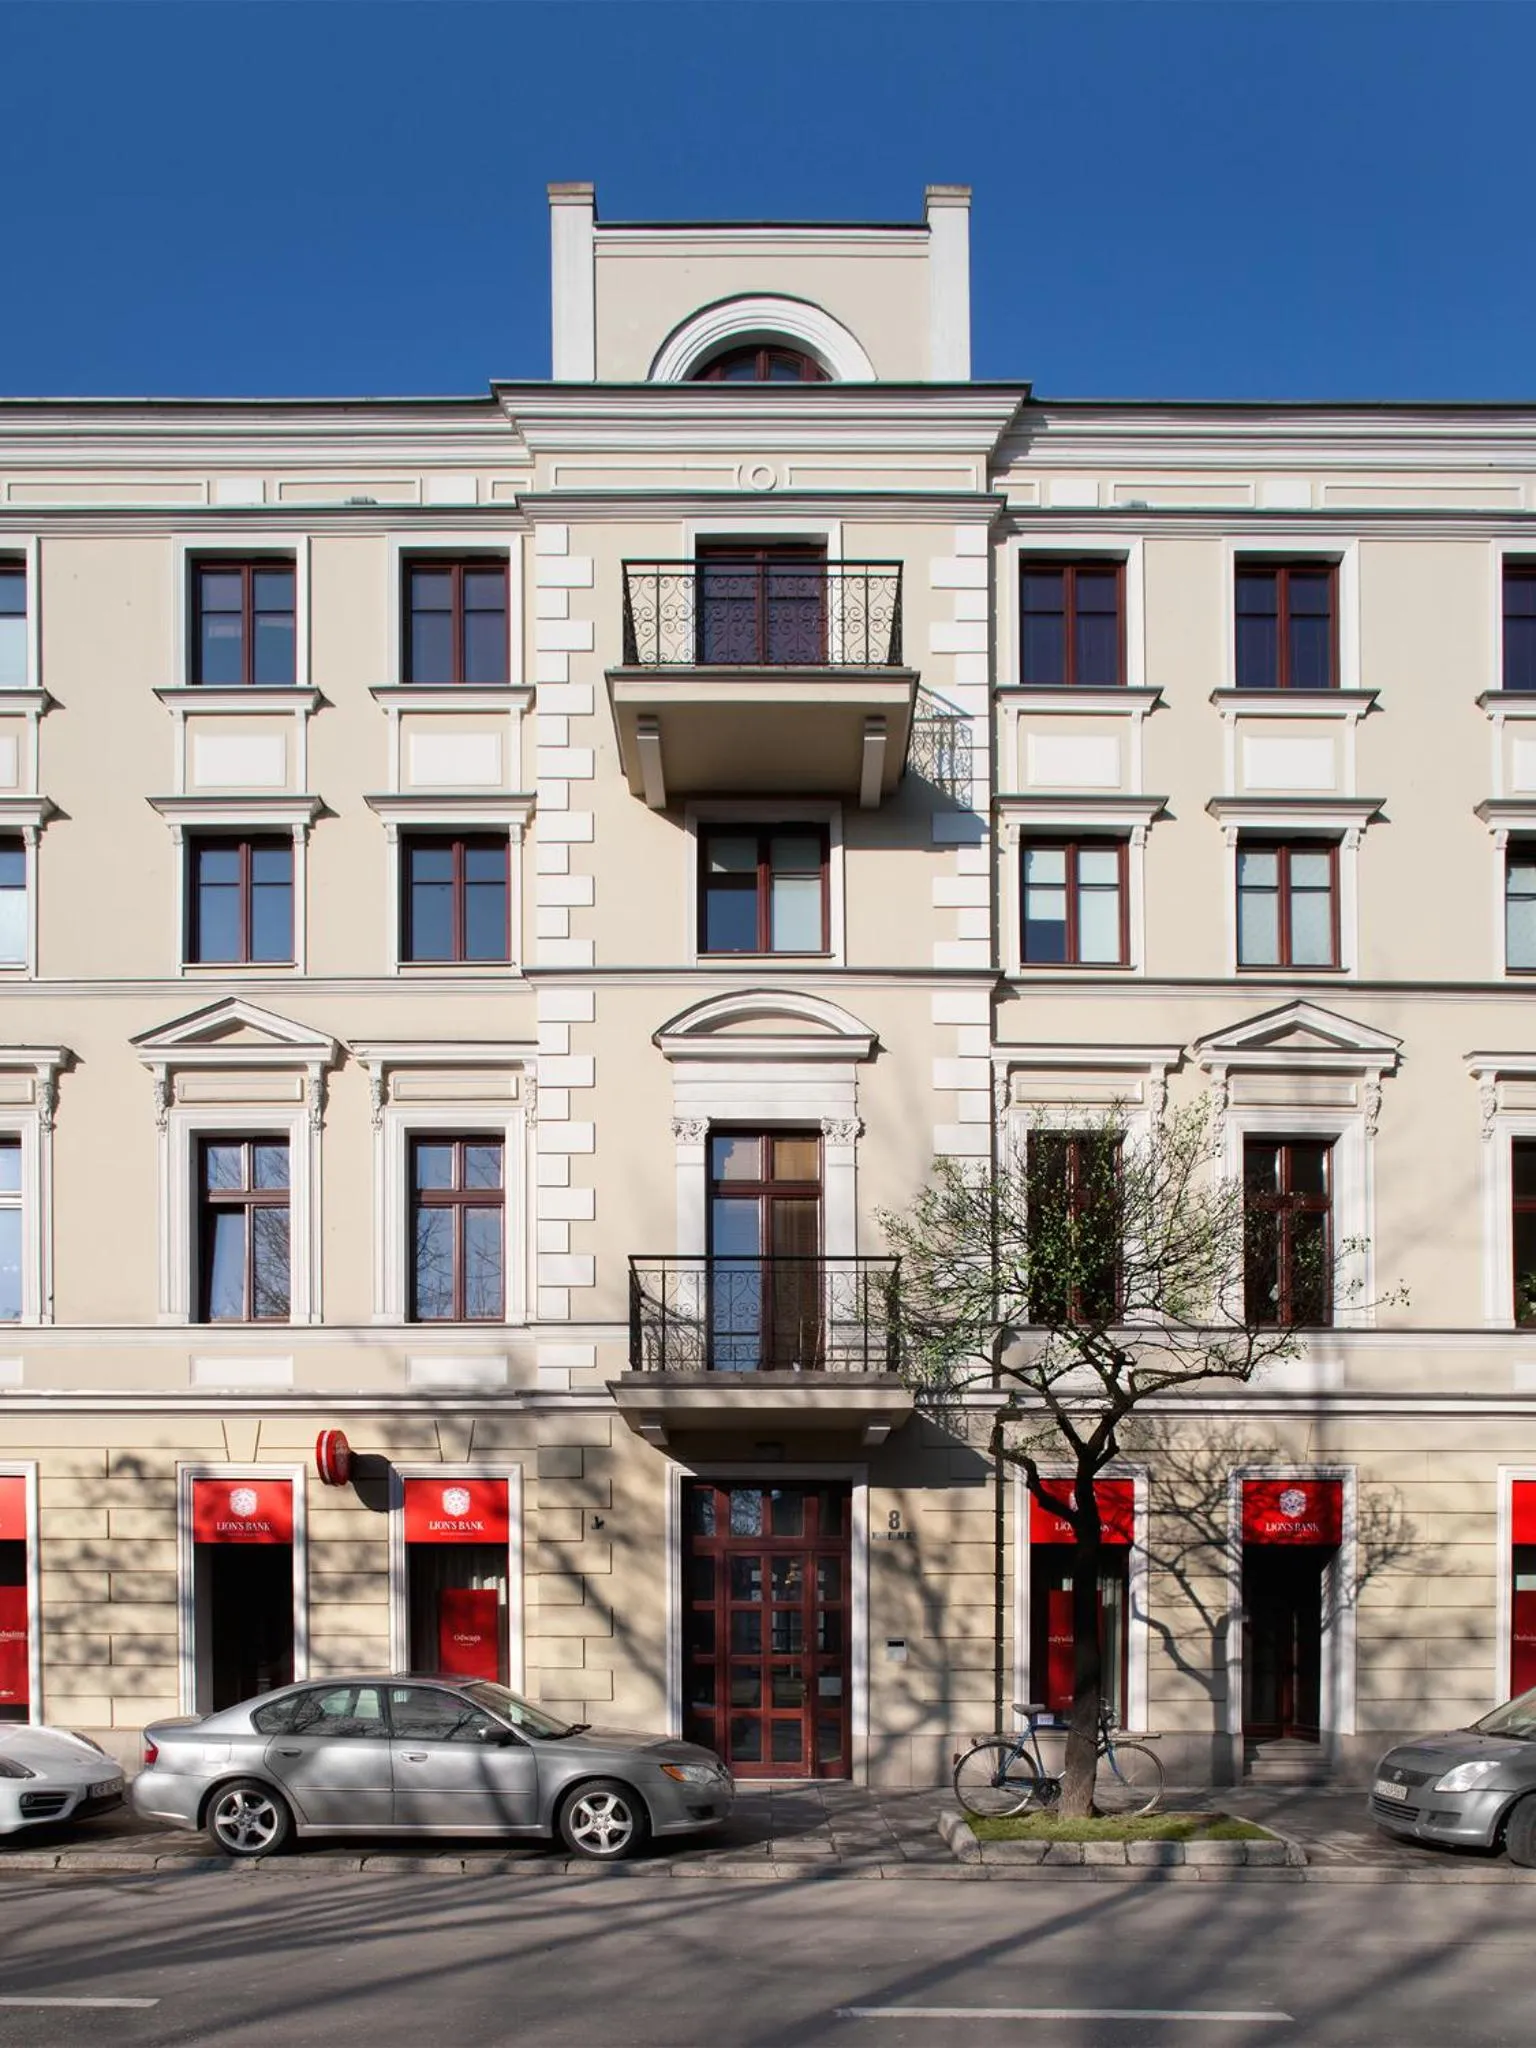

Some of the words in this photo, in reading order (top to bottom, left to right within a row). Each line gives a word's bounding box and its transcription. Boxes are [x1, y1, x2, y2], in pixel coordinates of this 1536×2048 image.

[889, 1510, 900, 1530] 8
[216, 1521, 244, 1531] LION'S
[245, 1521, 270, 1531] BANK
[429, 1521, 457, 1530] LION'S
[459, 1521, 484, 1530] BANK
[1294, 1523, 1320, 1532] BANK
